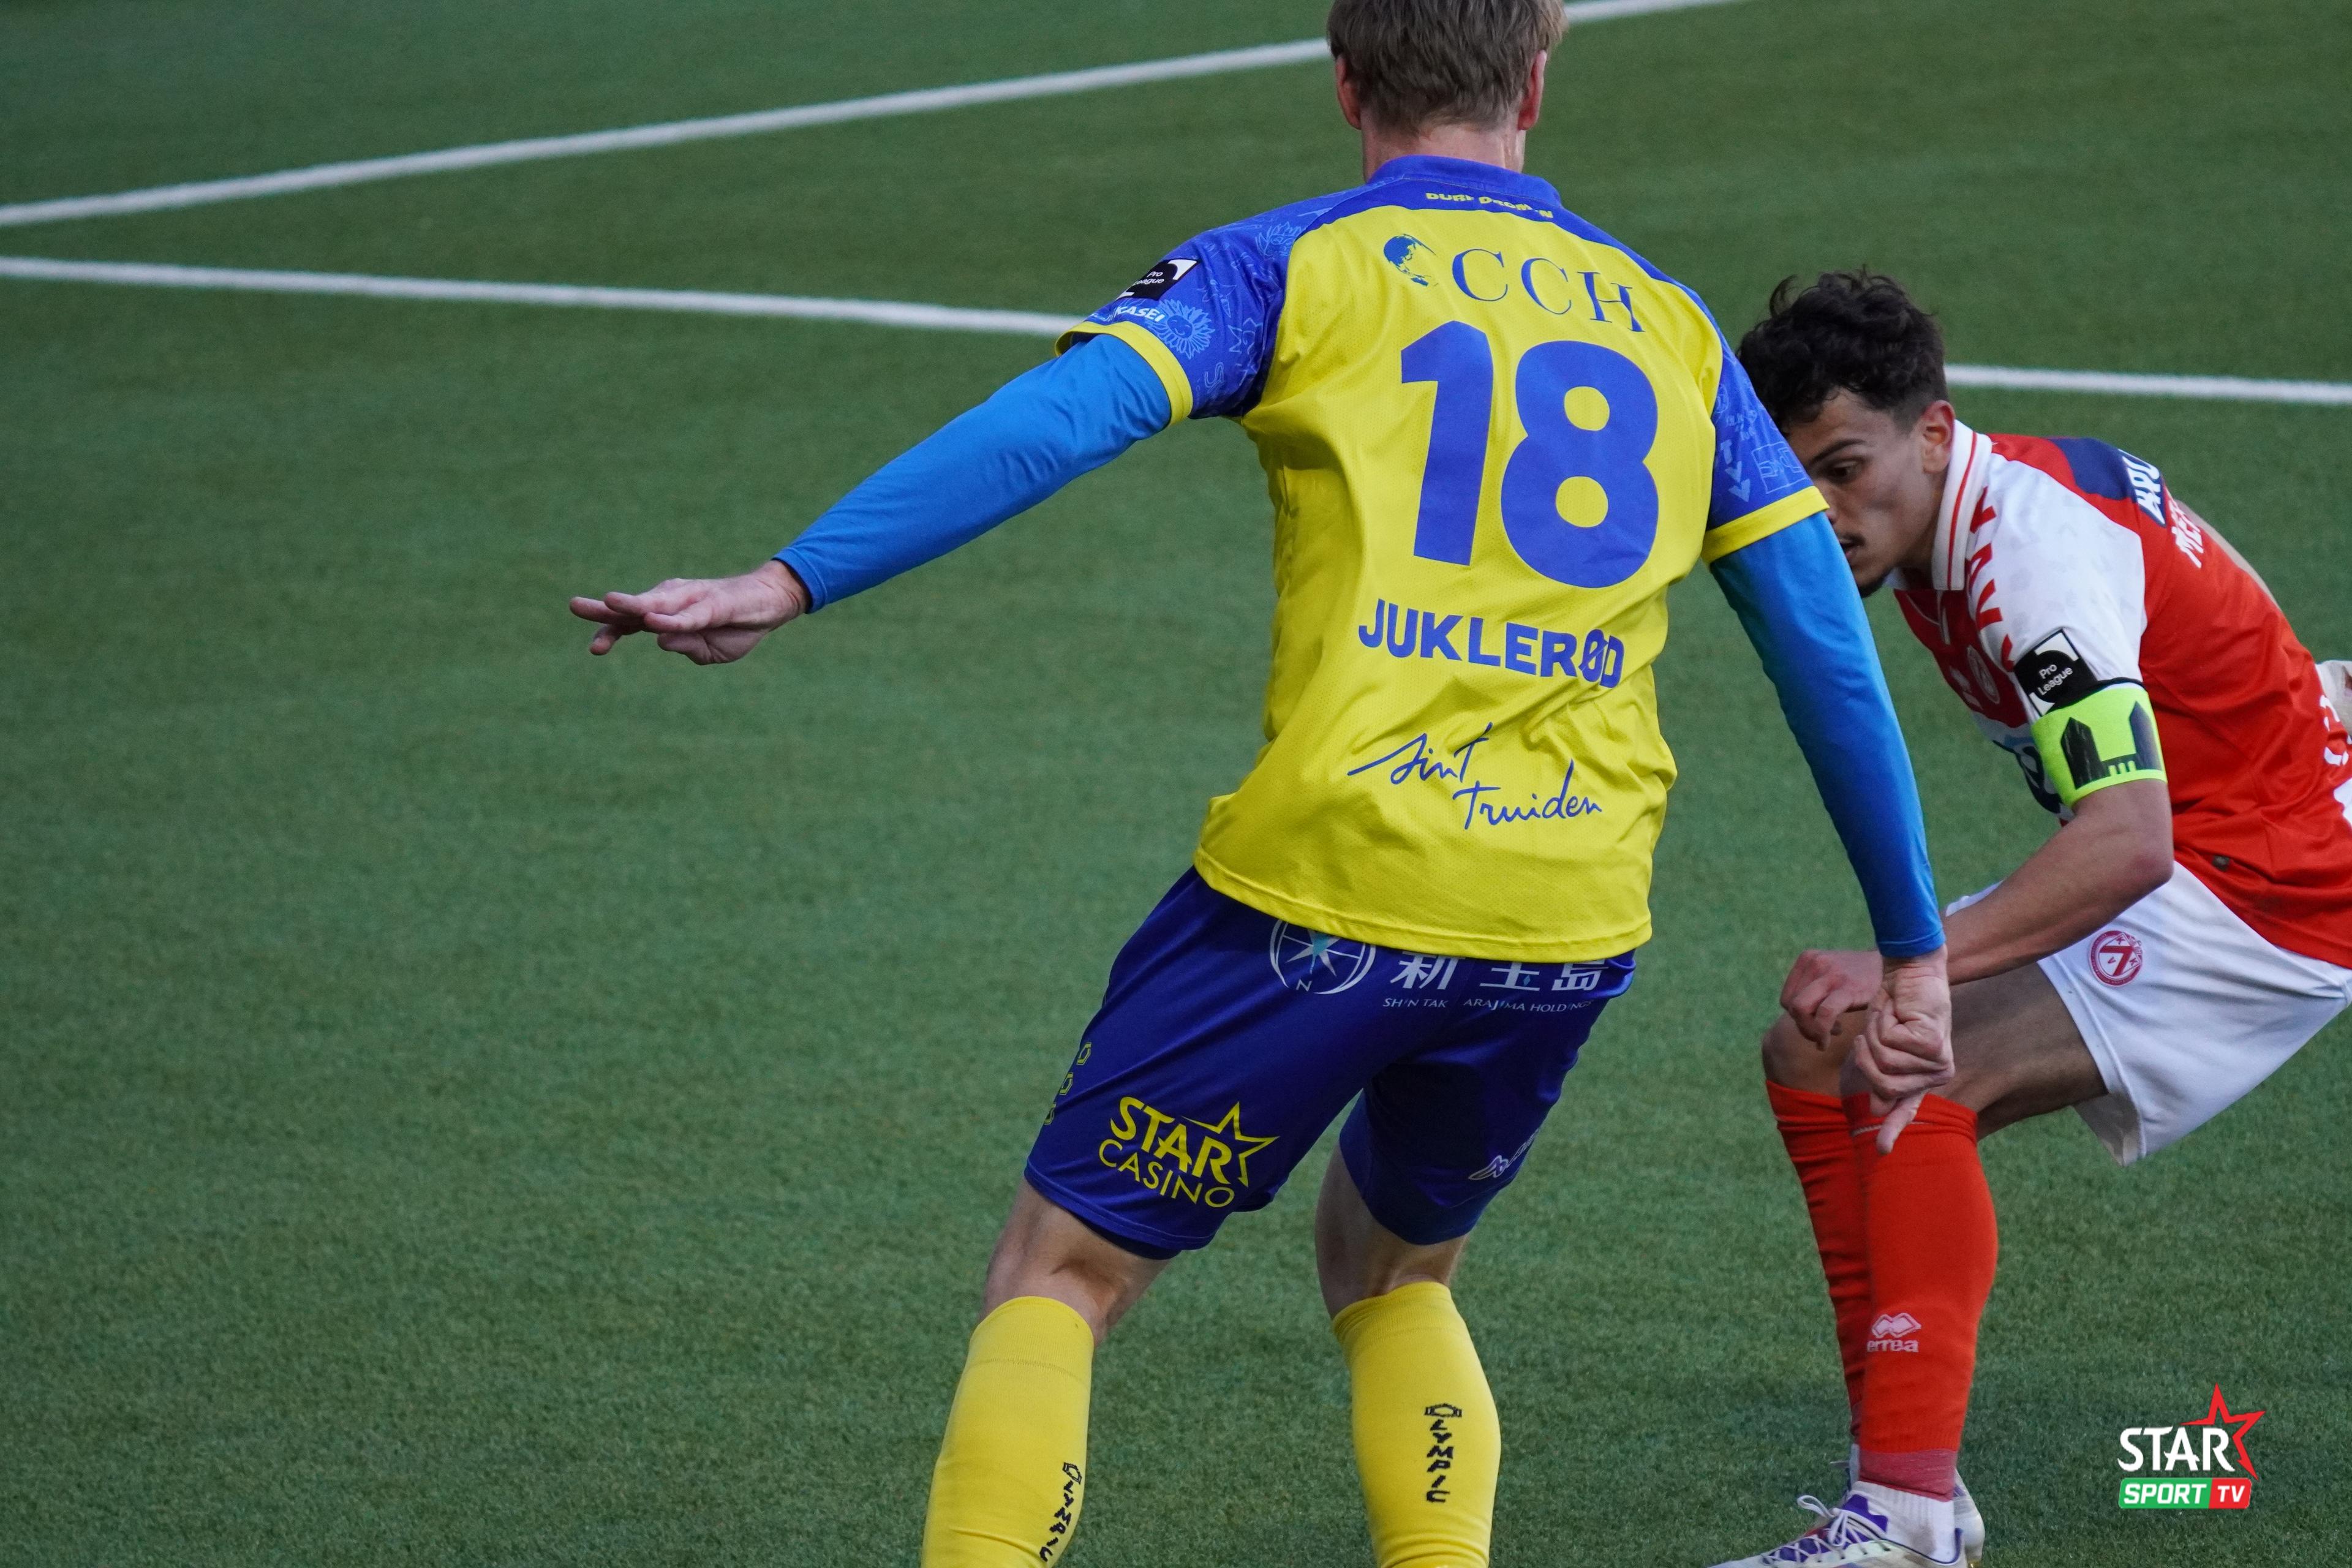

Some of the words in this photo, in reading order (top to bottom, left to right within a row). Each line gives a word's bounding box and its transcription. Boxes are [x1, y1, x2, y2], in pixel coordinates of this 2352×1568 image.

[1114, 306, 1166, 323] KASEI
[1451, 248, 1646, 333] CCH
[1400, 320, 1659, 589] 18
[1358, 598, 1625, 689] JUKLERØD
[2038, 664, 2057, 679] Pro
[2037, 668, 2073, 696] League
[1452, 758, 1602, 830] Truiden
[1098, 1139, 1235, 1208] CASINO
[1110, 1096, 1232, 1185] STAR
